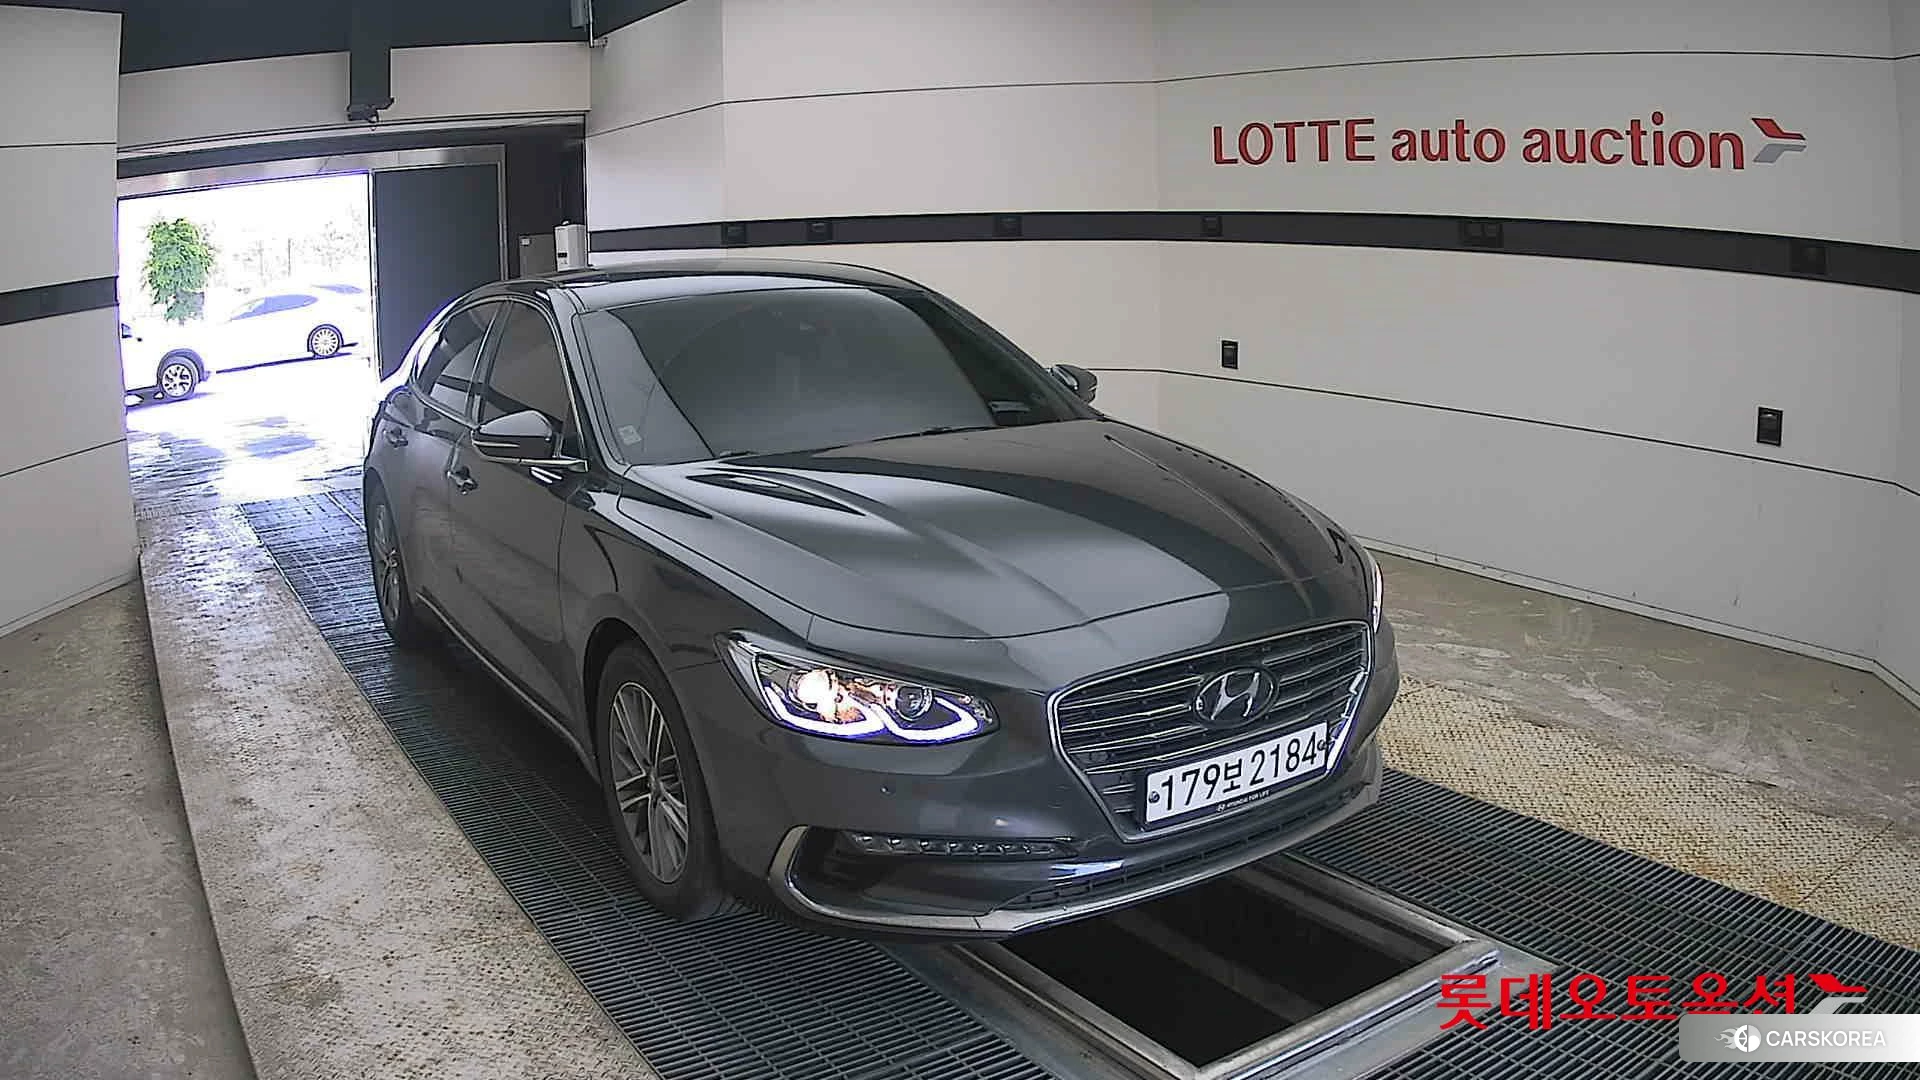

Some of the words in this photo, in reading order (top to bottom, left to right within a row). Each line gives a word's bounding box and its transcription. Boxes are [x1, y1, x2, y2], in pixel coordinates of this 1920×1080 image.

[1212, 118, 1376, 166] LOTTE
[1391, 118, 1507, 163] auto
[1522, 110, 1746, 170] auction
